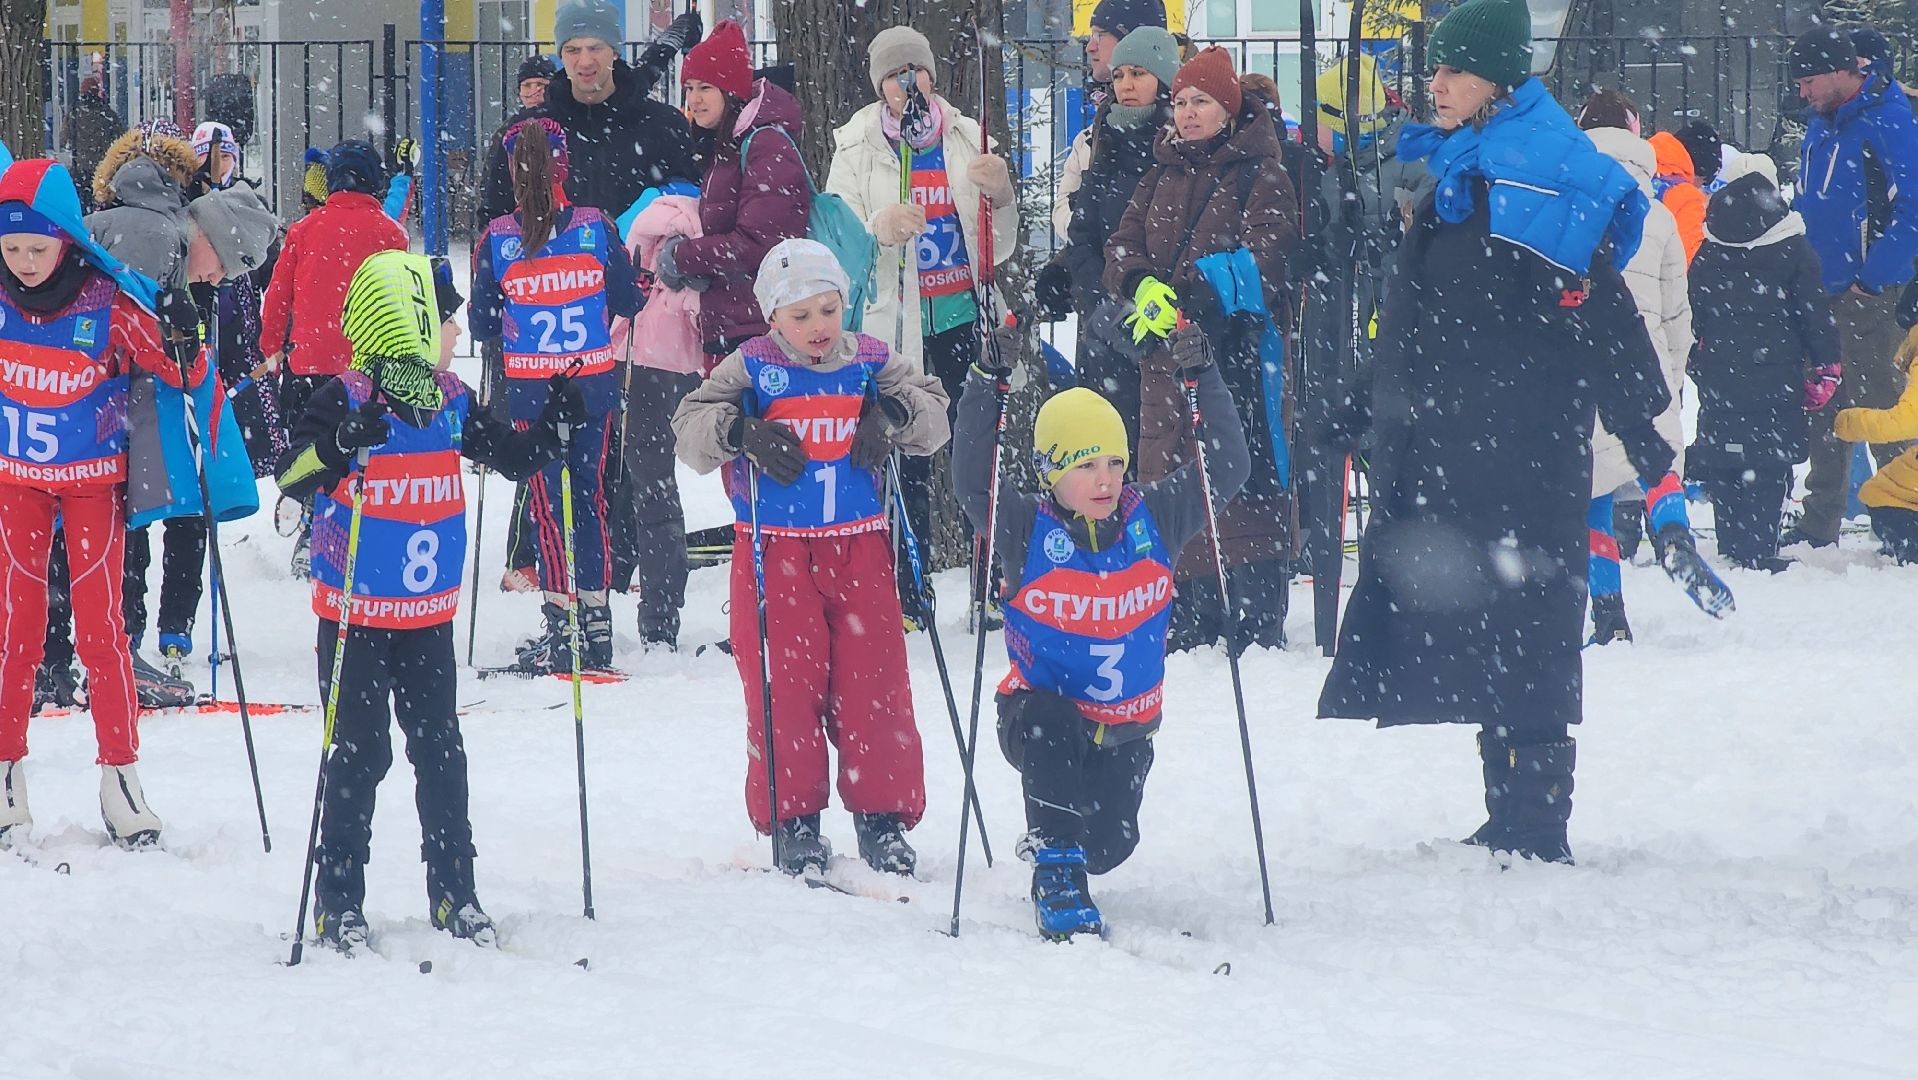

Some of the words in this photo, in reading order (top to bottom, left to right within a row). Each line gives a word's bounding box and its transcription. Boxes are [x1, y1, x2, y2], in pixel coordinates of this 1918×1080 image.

[914, 223, 960, 269] 67
[530, 305, 588, 353] 25
[2, 405, 59, 463] 15
[815, 465, 837, 524] 1
[402, 530, 439, 593] 8
[1024, 575, 1168, 621] СТУПИНО
[1083, 643, 1125, 701] 3
